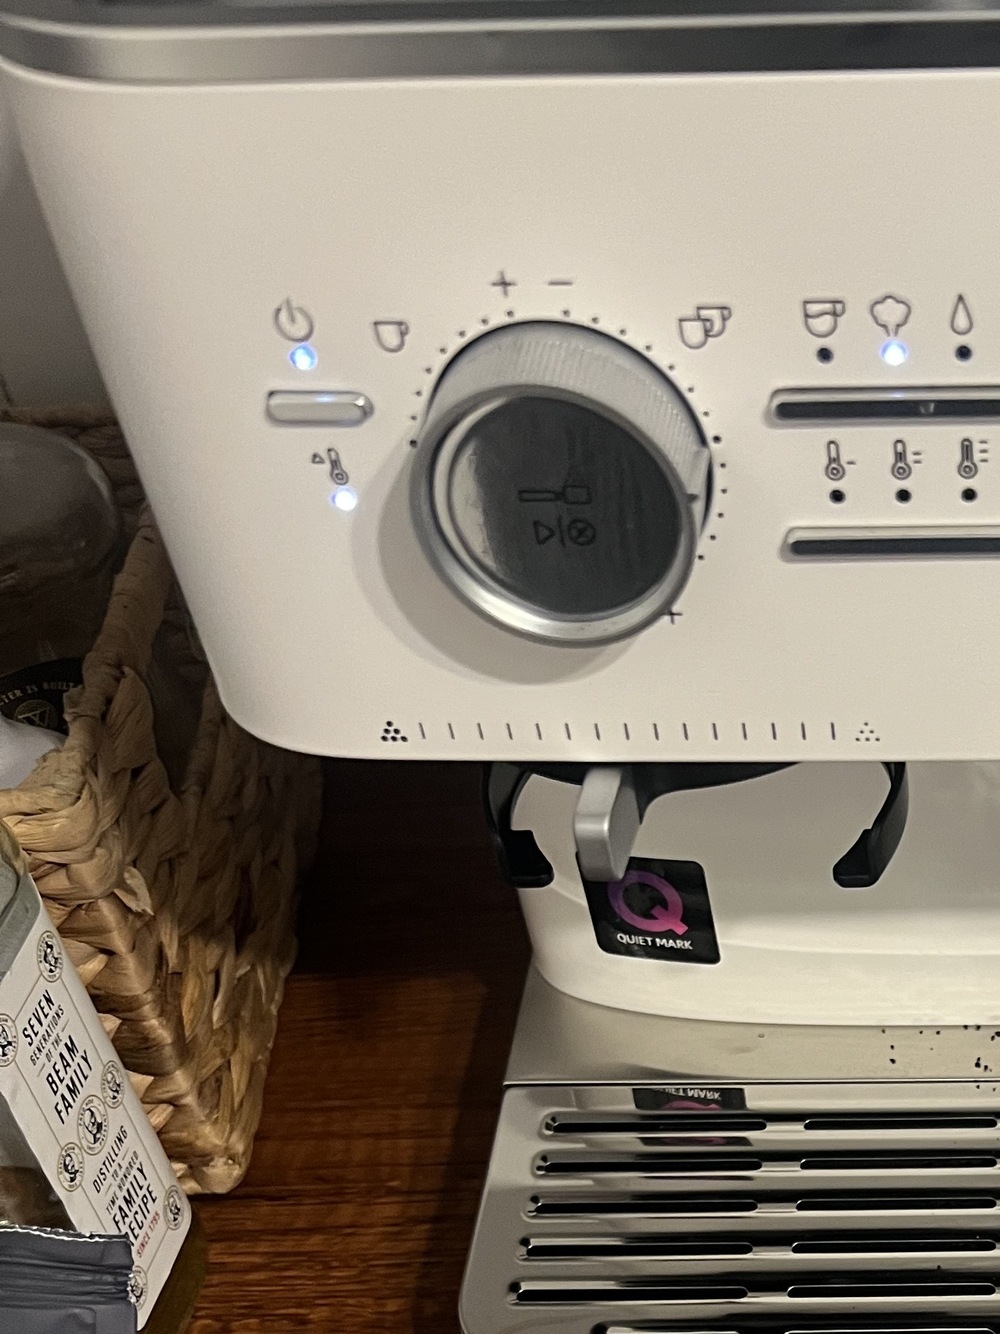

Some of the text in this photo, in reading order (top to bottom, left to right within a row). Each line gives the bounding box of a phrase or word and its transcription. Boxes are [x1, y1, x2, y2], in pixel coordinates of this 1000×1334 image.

[616, 932, 693, 951] QUIET MARK
[22, 989, 55, 1047] SEVEN
[30, 1004, 65, 1066] GENERATIONS
[45, 1032, 63, 1063] OF THE
[46, 1034, 79, 1096] BEAM
[54, 1049, 93, 1125] FAMILY
[92, 1125, 128, 1194] DISTILLING
[106, 1150, 139, 1215] TIME HONORED
[112, 1161, 149, 1233] FAMILY
[137, 1230, 151, 1258] SINCE
